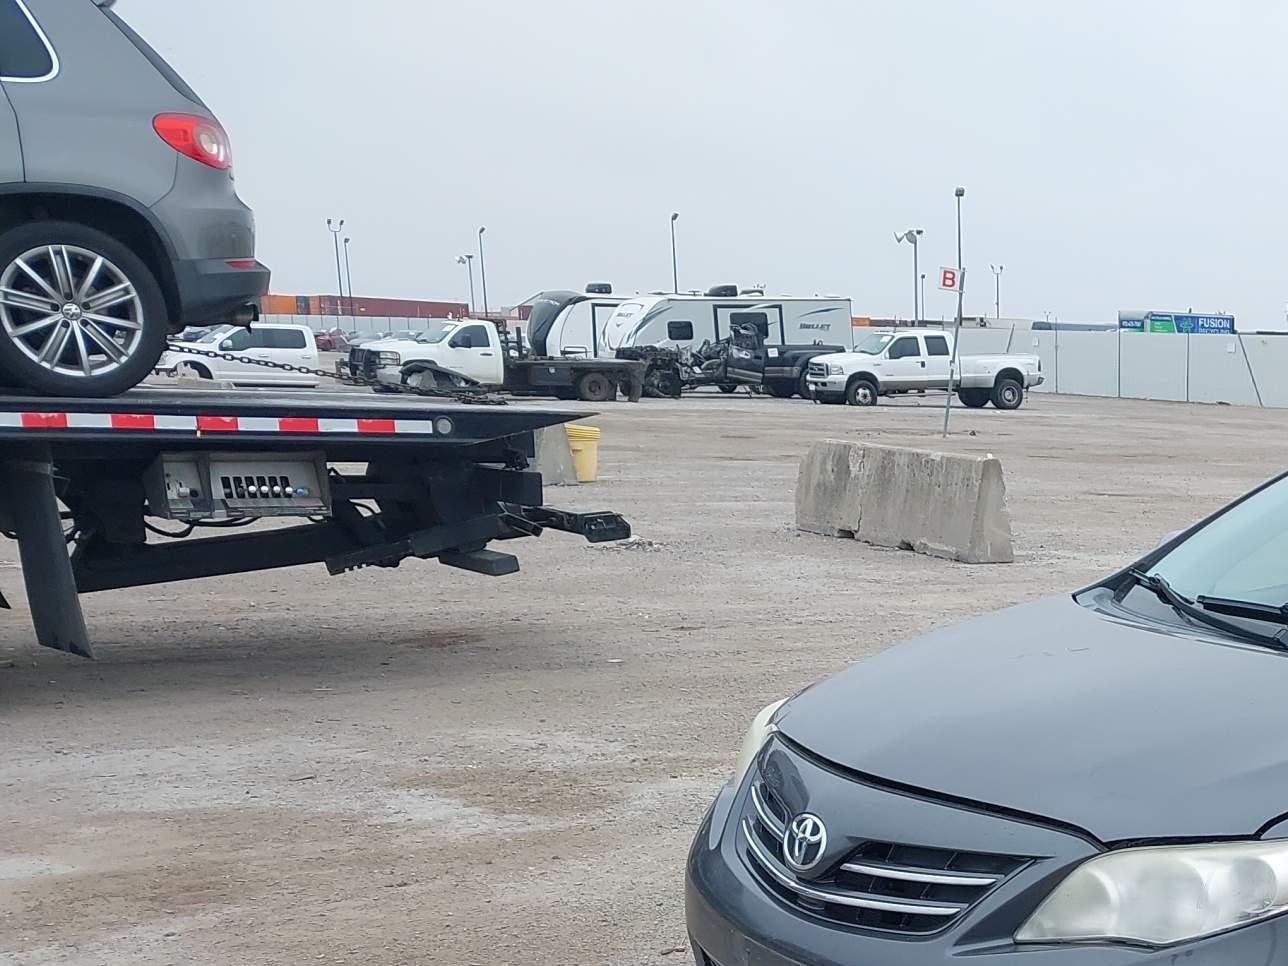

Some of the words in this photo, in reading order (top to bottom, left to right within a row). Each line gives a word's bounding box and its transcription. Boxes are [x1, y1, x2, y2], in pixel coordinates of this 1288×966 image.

[942, 270, 956, 288] B
[800, 323, 831, 331] BULLET
[1198, 318, 1230, 328] FUSION
